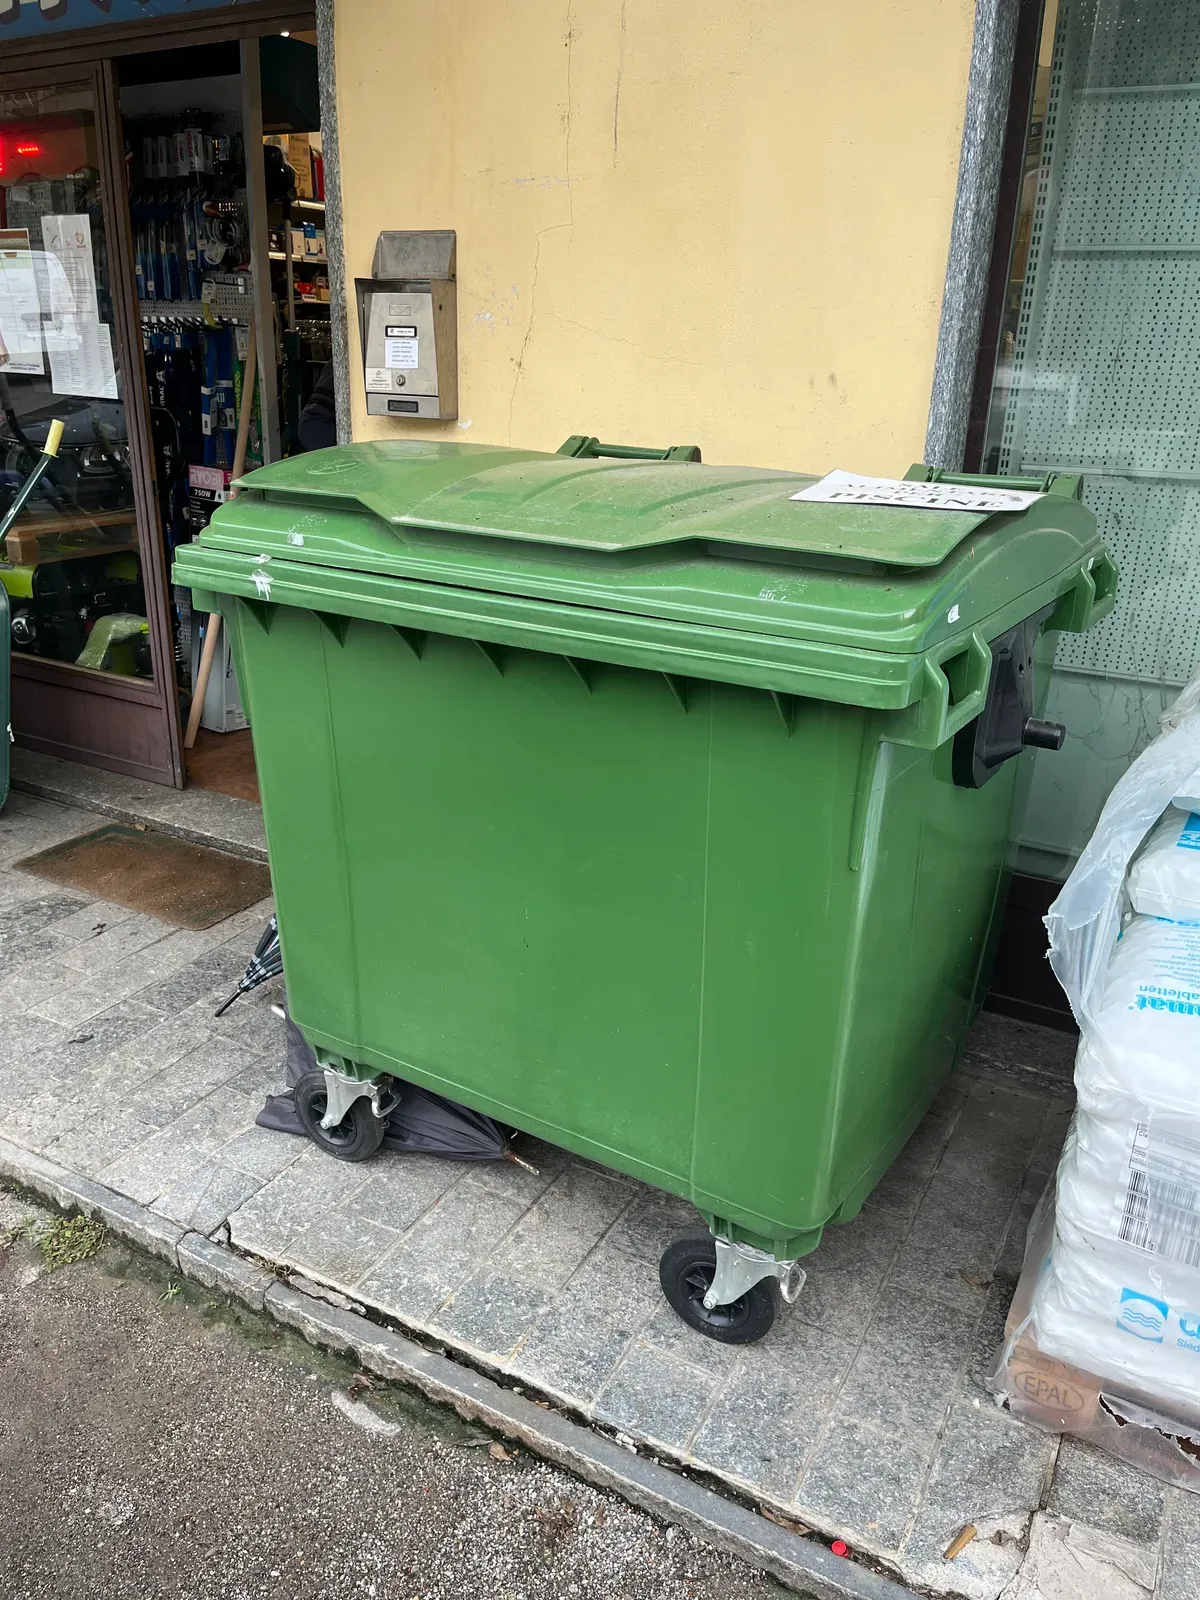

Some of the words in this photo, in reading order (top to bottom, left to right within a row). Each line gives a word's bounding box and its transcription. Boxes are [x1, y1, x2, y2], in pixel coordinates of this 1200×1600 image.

[190, 469, 221, 487] RYOBI
[194, 489, 211, 498] 750W
[828, 493, 1003, 507] PISCINE
[1024, 1375, 1073, 1408] EPAL
